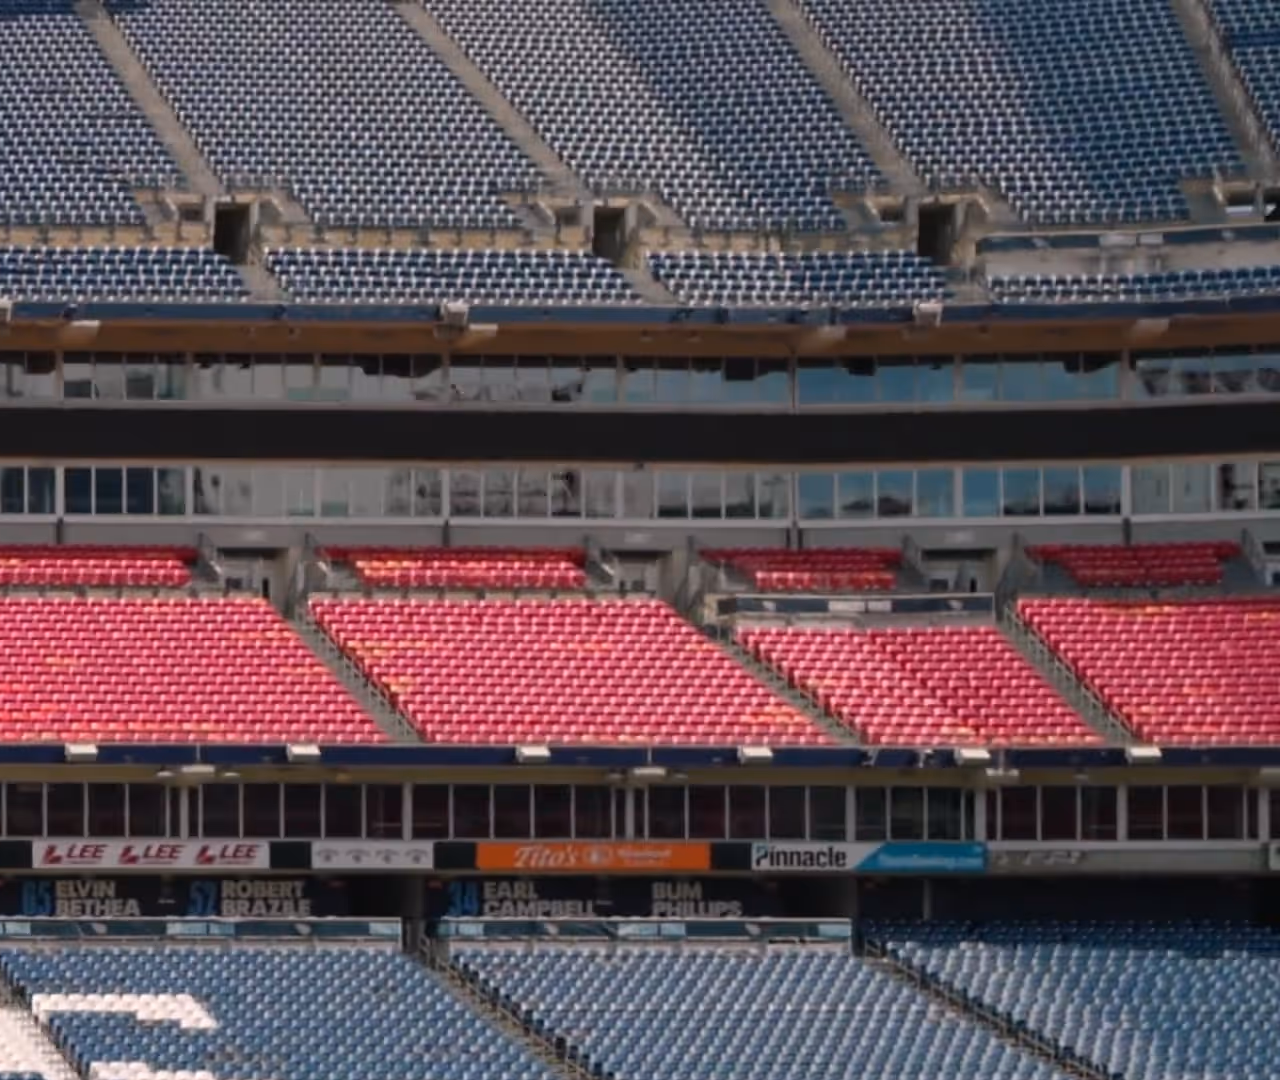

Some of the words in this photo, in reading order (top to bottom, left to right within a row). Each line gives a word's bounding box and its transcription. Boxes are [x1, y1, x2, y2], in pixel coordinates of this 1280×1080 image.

[66, 844, 107, 860] LEE
[142, 844, 184, 860] LEE
[218, 844, 261, 860] LEE
[513, 845, 578, 868] Tito's
[755, 845, 848, 868] Pinnacle
[55, 880, 116, 898] ELVIN
[221, 880, 305, 898] ROBERT
[483, 881, 538, 899] EARL
[651, 882, 703, 899] BUM
[55, 898, 140, 917] BETHEA
[483, 899, 596, 918] CAMPBELL
[651, 900, 743, 918] PHILLIPS
